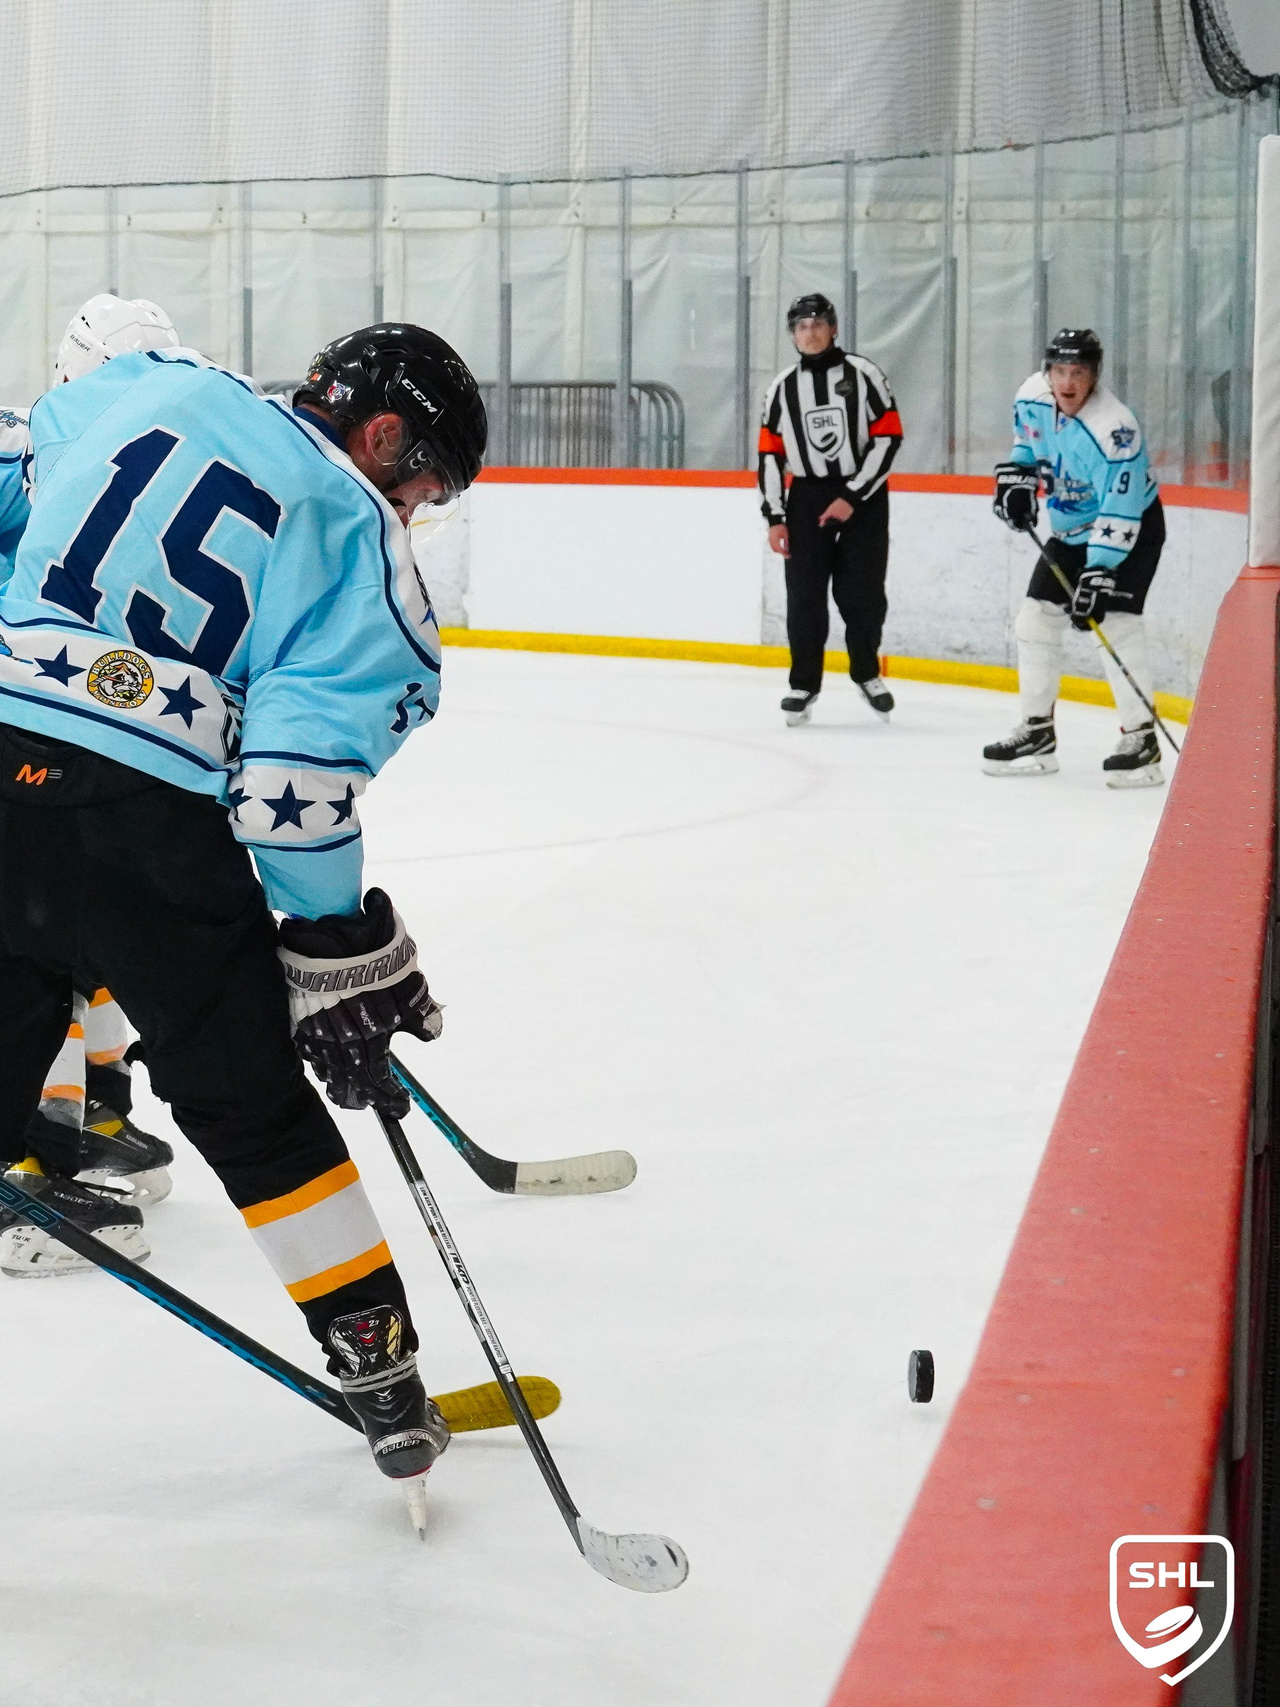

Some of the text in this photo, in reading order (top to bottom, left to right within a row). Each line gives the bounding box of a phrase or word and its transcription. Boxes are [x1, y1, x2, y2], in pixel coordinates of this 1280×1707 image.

[401, 377, 439, 414] CCM
[811, 415, 838, 429] SHL
[41, 425, 284, 678] 15
[91, 651, 151, 679] BULLDOGS
[285, 932, 418, 993] WARRIO
[381, 1438, 421, 1454] BAUER
